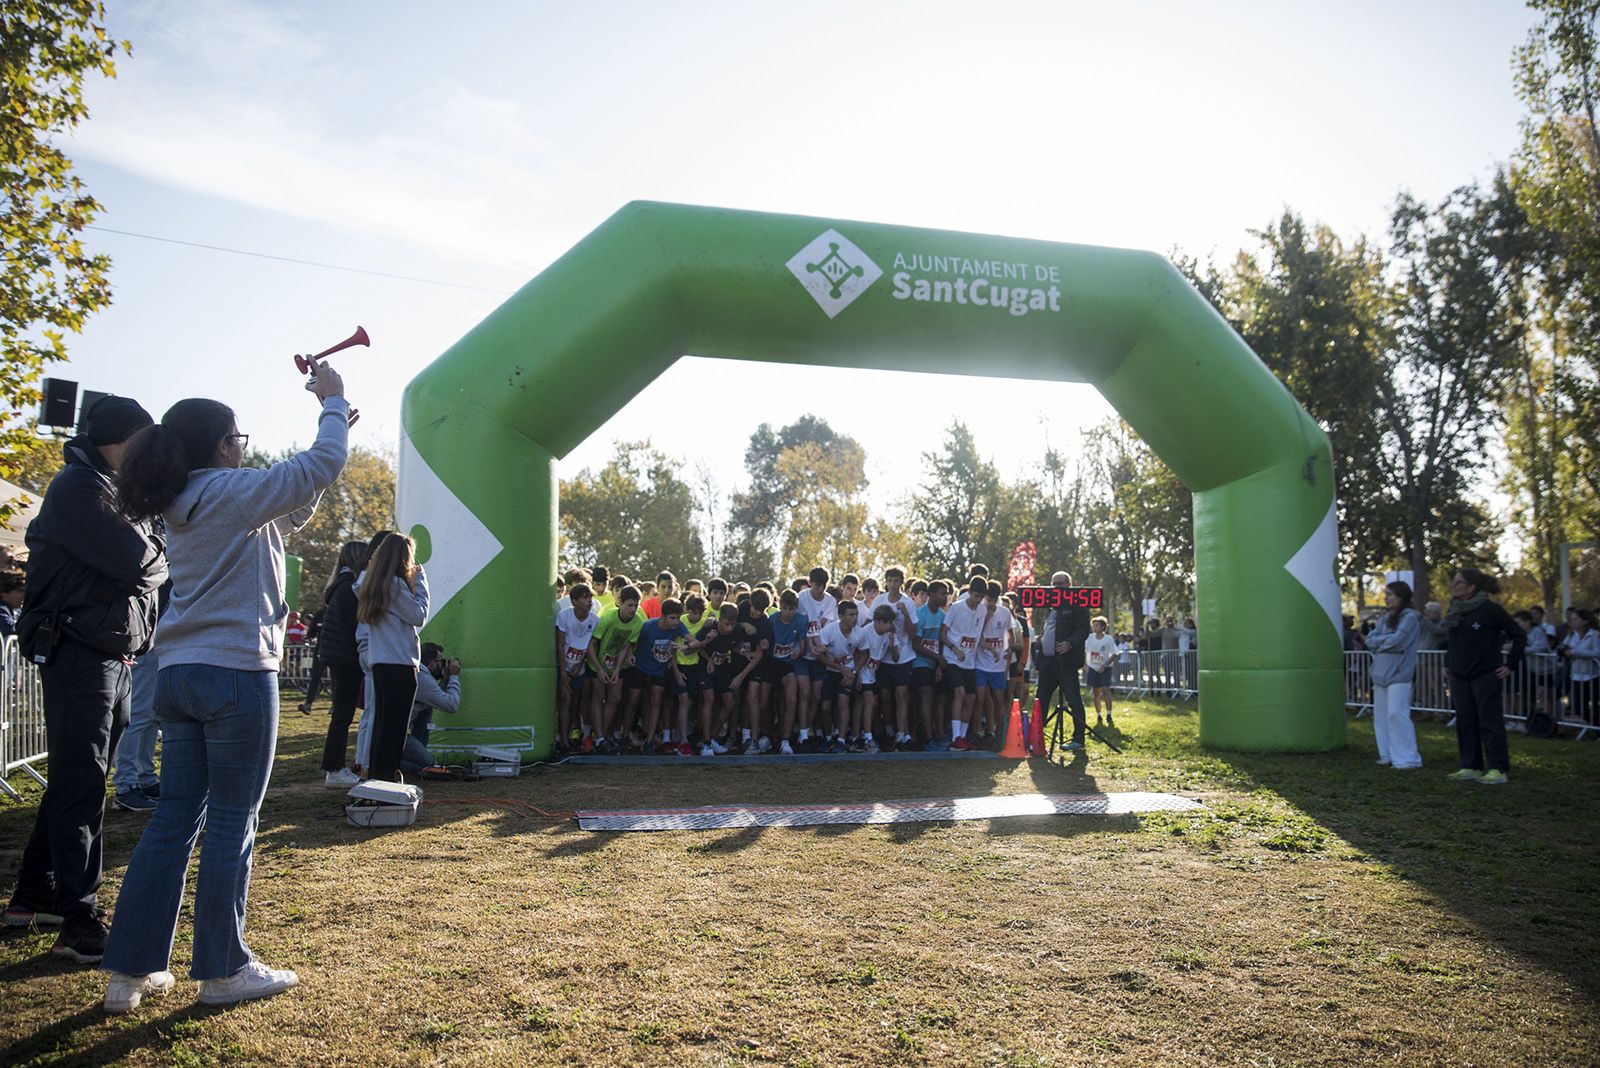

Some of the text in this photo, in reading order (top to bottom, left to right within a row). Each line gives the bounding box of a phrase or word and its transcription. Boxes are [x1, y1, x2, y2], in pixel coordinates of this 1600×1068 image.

[893, 252, 1062, 282] AJUNTAMENT DE
[892, 272, 1062, 316] SantCugat
[1022, 589, 1101, 607] 09:34:58
